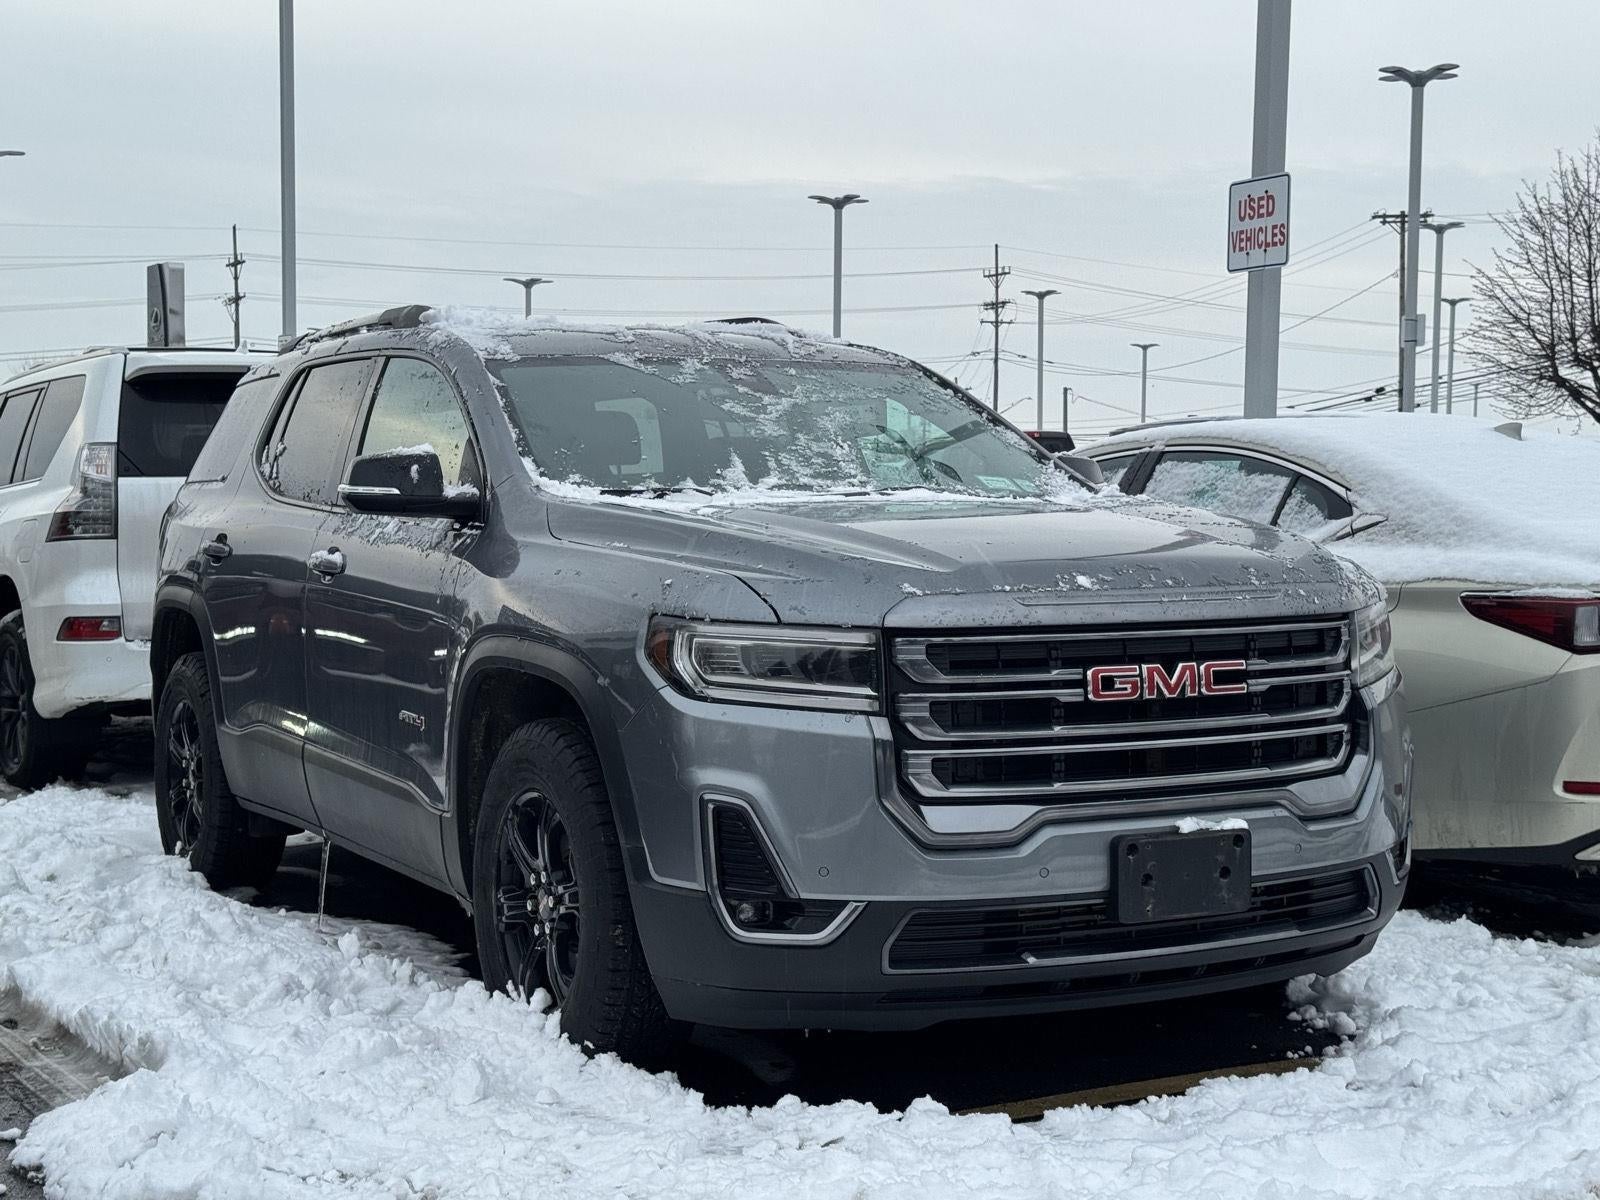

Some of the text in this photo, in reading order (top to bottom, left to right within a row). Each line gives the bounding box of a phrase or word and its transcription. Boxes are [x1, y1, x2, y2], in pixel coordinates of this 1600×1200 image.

[1238, 193, 1276, 222] USED
[1231, 223, 1286, 253] VEHICLES
[1086, 660, 1247, 701] GMC
